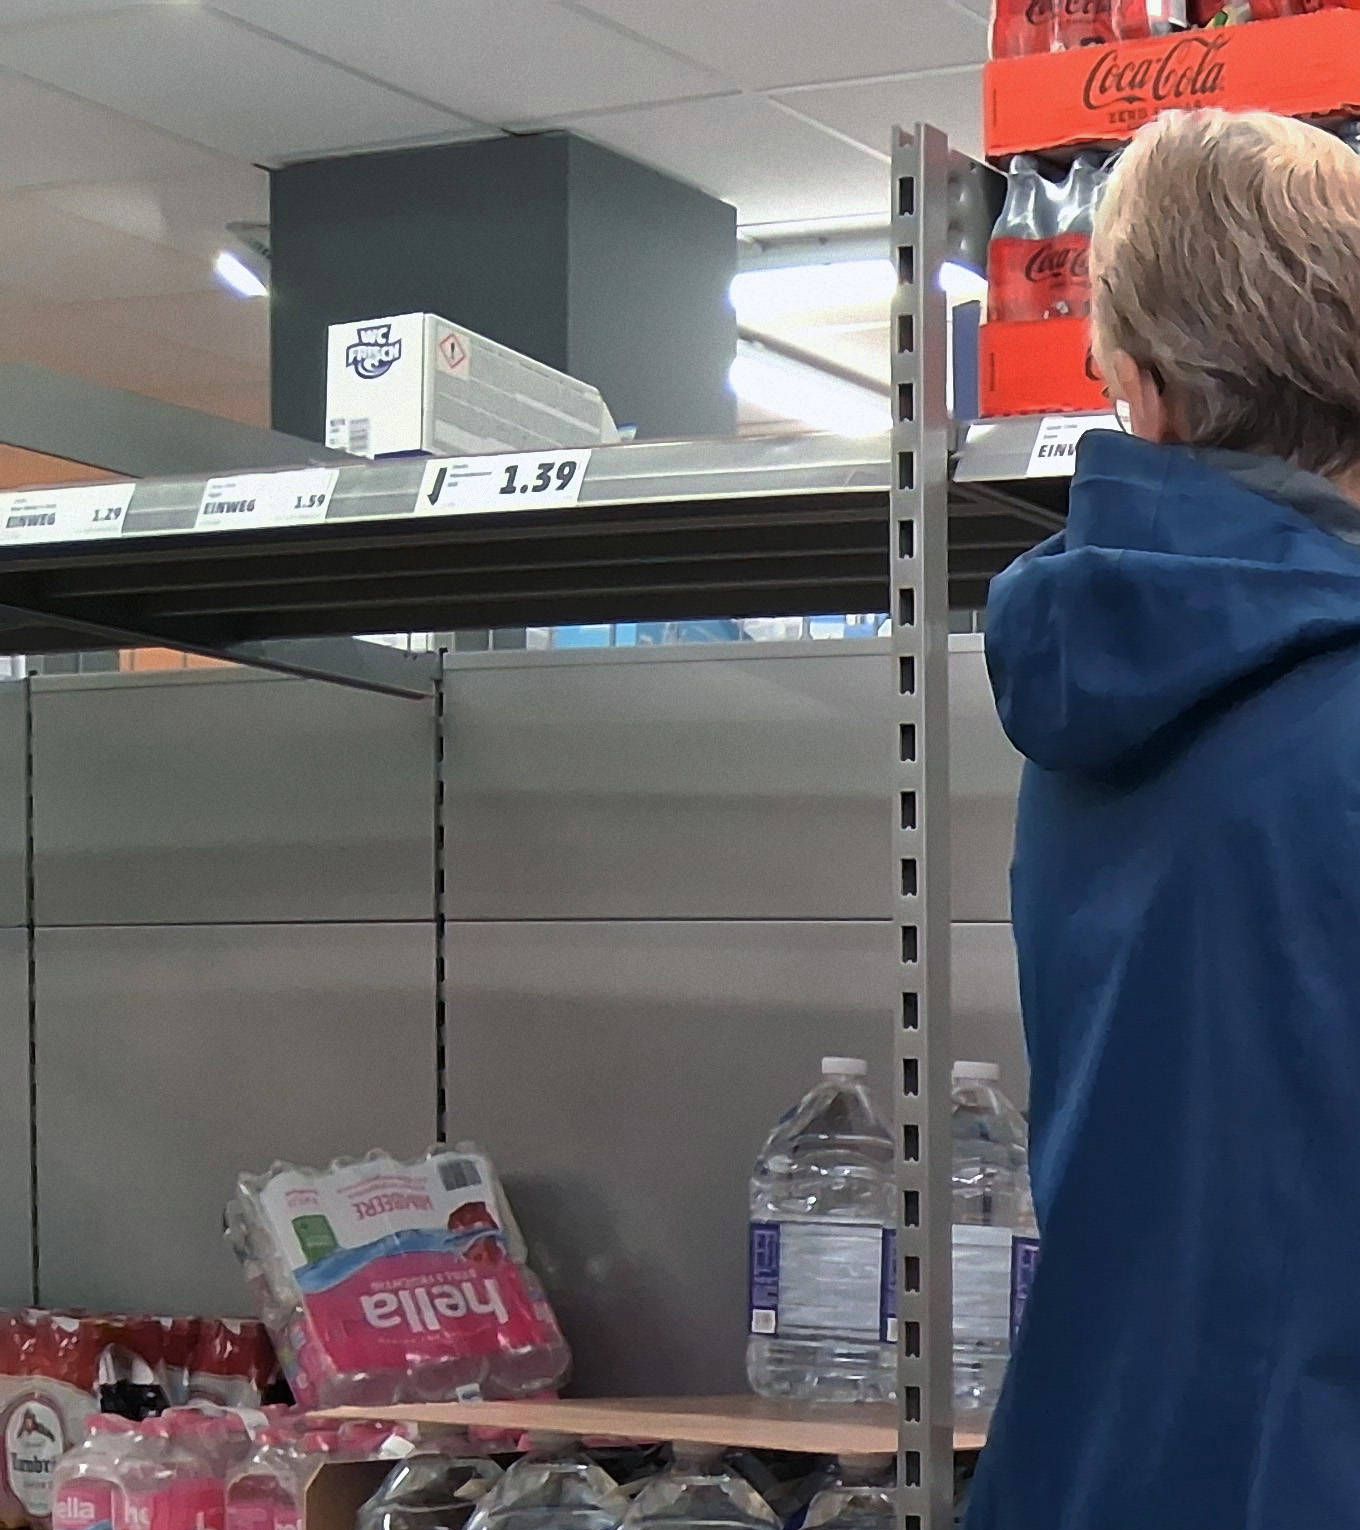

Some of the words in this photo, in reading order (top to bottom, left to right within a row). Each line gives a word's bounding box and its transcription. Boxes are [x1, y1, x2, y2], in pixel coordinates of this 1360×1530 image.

[1083, 34, 1232, 110] Coca-Cola
[1038, 443, 1076, 458] EIN
[499, 461, 577, 494] 1.39
[92, 507, 122, 522] 1.29
[204, 500, 255, 515] EINWEG
[294, 494, 326, 509] 1.59
[359, 1279, 510, 1333] hella
[57, 1497, 96, 1519] ella
